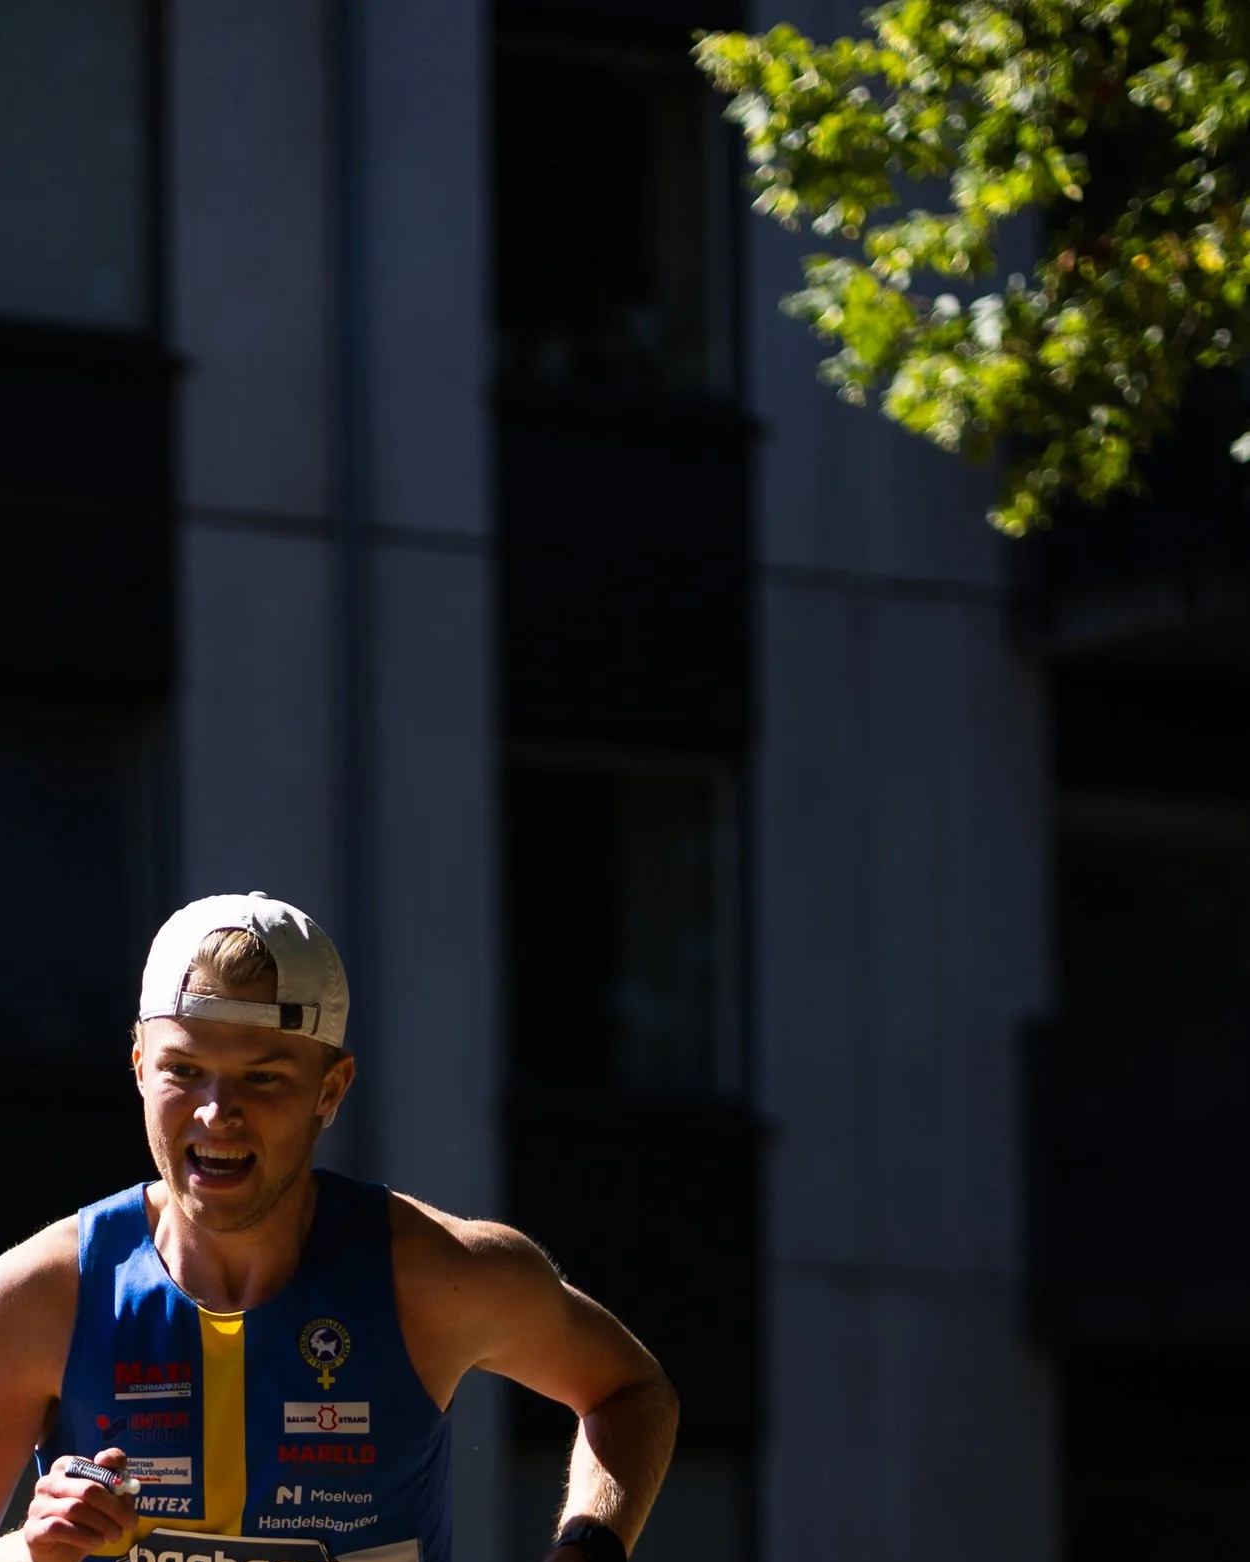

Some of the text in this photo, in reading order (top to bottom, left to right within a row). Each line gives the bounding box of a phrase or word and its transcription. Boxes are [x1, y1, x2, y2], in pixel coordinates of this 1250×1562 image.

[114, 1360, 192, 1382] MAXI
[131, 1411, 189, 1430] INTER
[338, 1416, 368, 1424] STRAND
[278, 1443, 377, 1464] MARELD
[134, 1495, 192, 1513] IMTEX
[310, 1488, 373, 1504] Moelven
[258, 1514, 378, 1532] Handelsbanken
